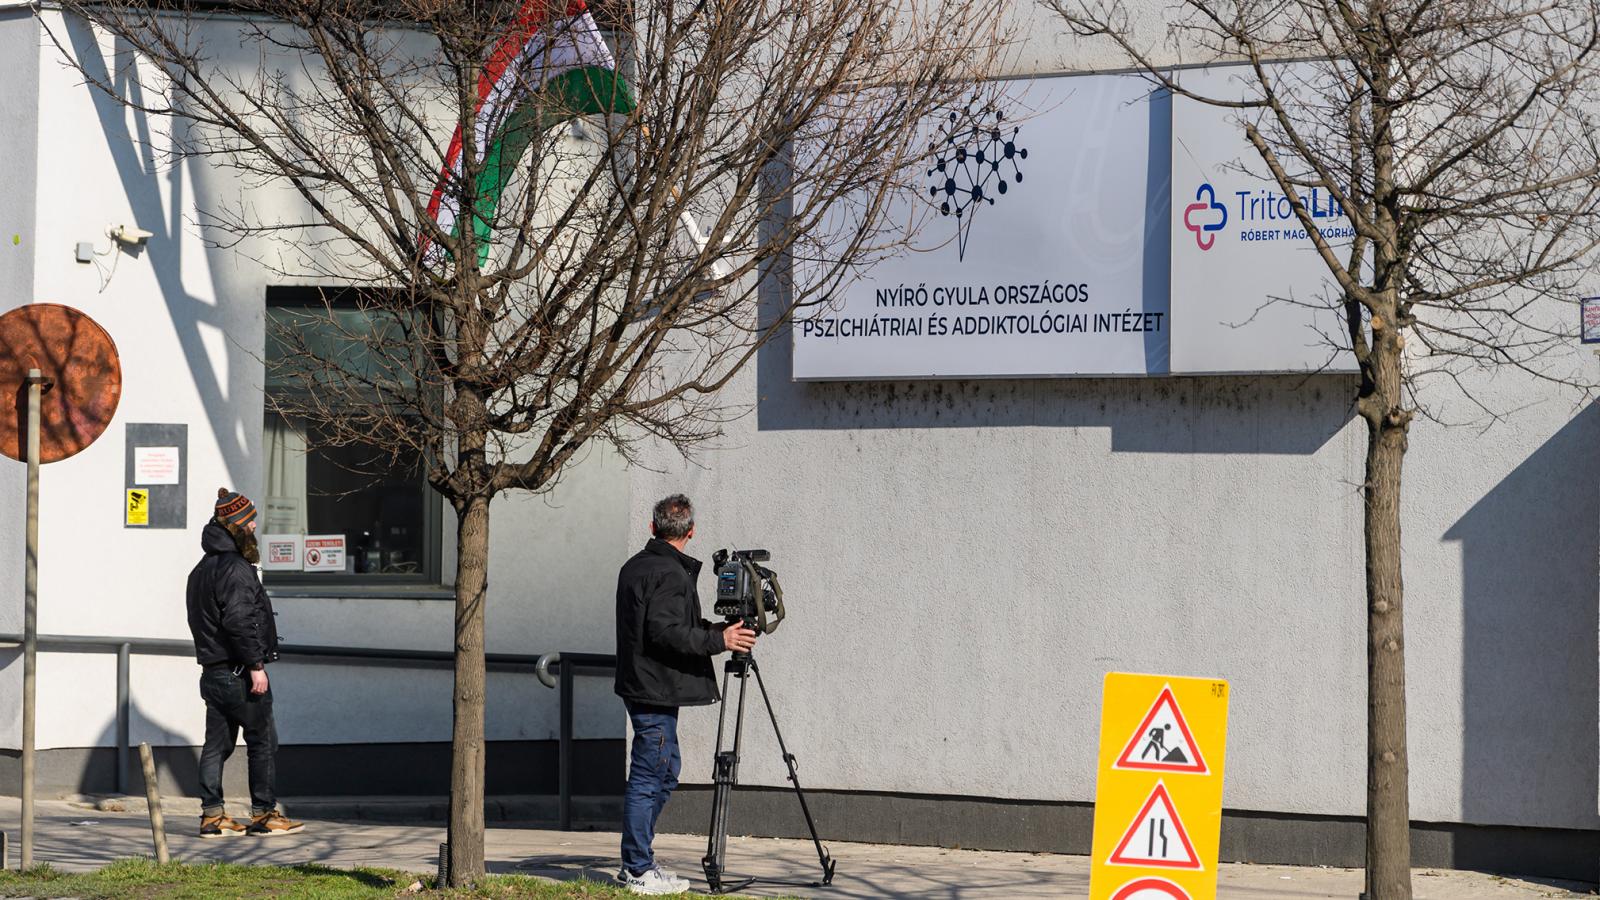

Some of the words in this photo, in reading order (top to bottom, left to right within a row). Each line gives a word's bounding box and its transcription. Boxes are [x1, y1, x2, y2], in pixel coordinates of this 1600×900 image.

[1240, 228, 1281, 241] RÓBERT
[876, 283, 928, 307] NYÍRŐ
[933, 286, 989, 306] GYULA
[994, 280, 1089, 304] ORSZÁGOS
[803, 313, 922, 337] PSZICHIÁTRIAI
[927, 312, 948, 336] ÉS
[951, 310, 1087, 335] ADDIKTOLÓGIAI
[1093, 308, 1164, 333] INTÉZET
[627, 879, 645, 887] HOKA
